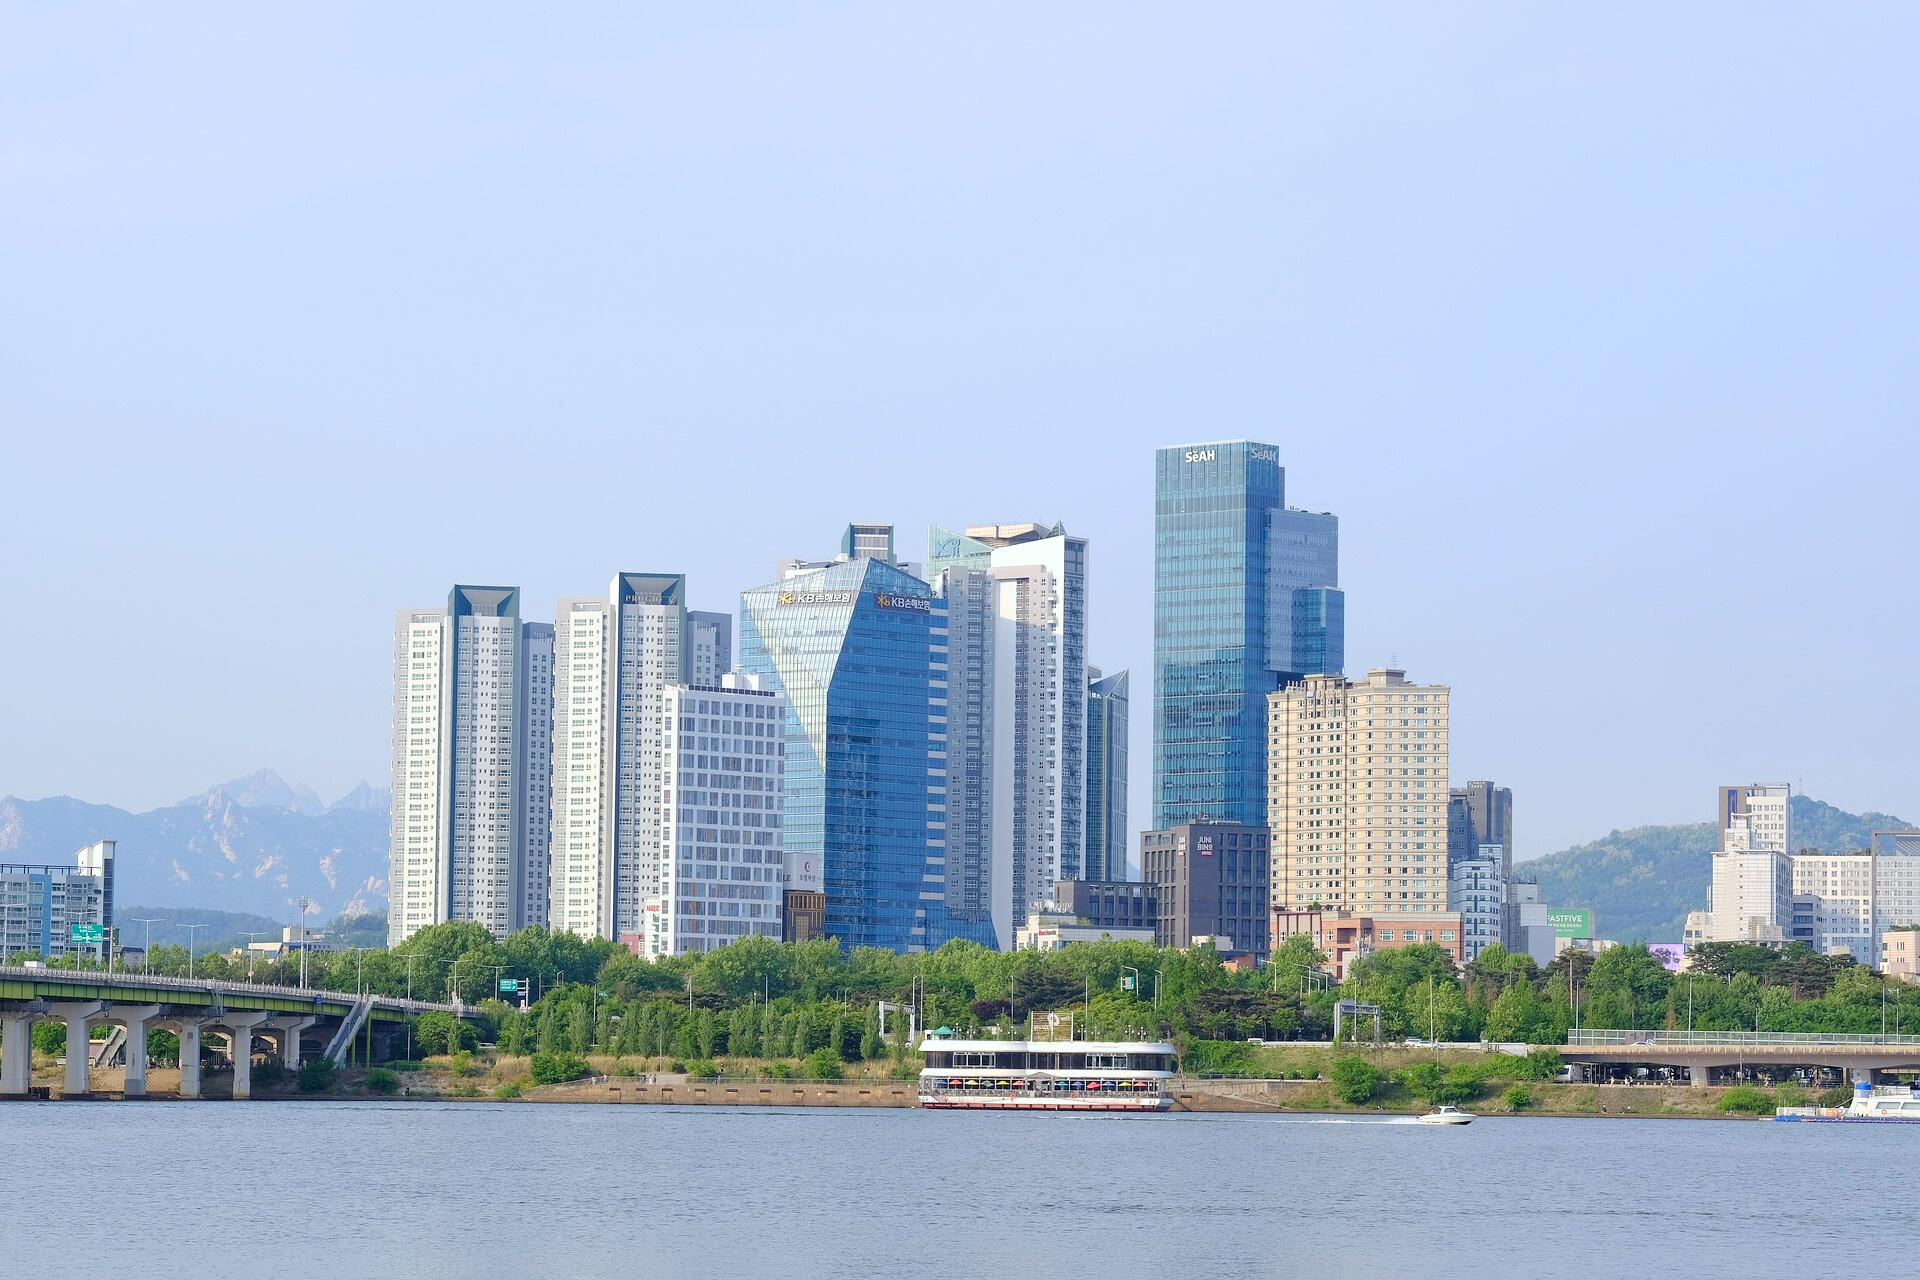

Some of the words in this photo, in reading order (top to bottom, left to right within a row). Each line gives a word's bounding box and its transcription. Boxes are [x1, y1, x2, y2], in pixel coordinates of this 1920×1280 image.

[1185, 450, 1215, 462] SeAH
[625, 595, 662, 603] PRUGIO
[891, 597, 930, 610] KB손해보험
